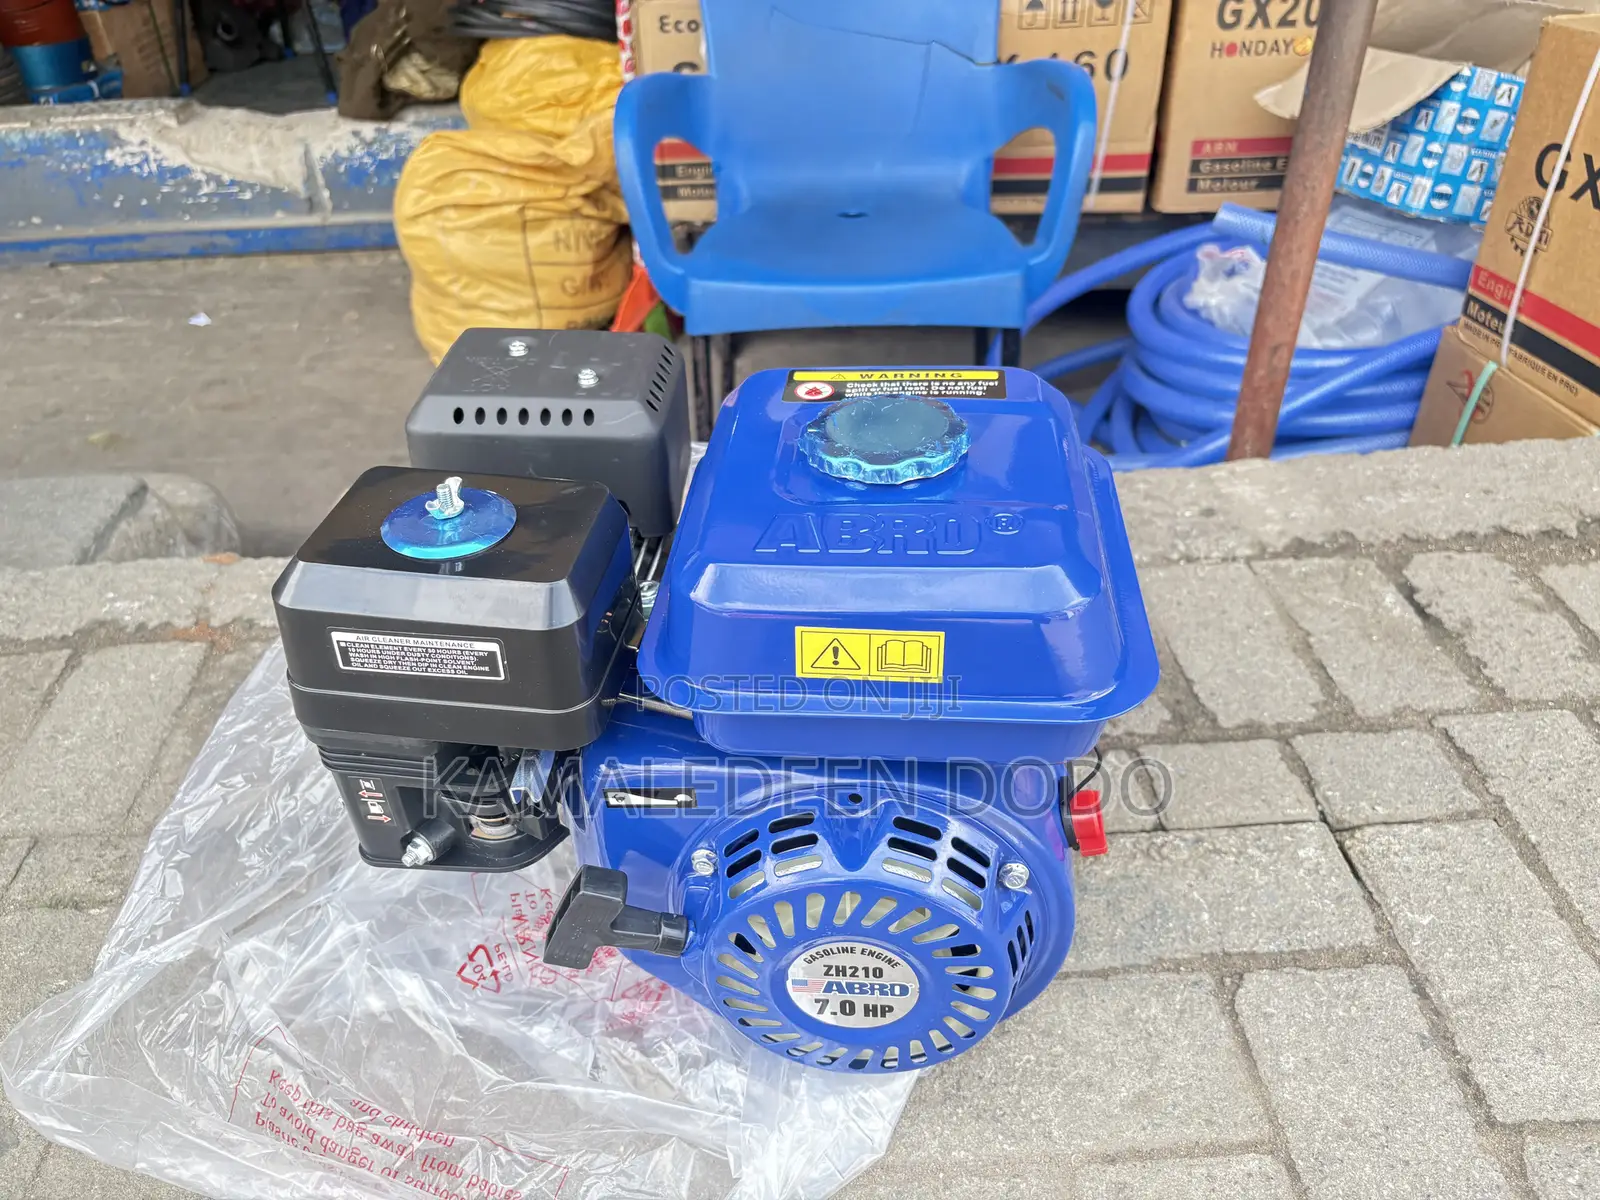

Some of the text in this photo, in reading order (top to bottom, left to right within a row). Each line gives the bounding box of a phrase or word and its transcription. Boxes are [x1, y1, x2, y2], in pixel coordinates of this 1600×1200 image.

[859, 372, 963, 380] WARNING
[370, 643, 403, 651] ELEMENT
[371, 636, 411, 645] CLEANER
[412, 639, 475, 649] MAINTENANCE
[463, 664, 490, 672] ENGINE
[803, 946, 901, 969] GASOLINE ENGINE
[822, 964, 884, 978] ZH210
[822, 980, 911, 997] ABRO
[814, 998, 895, 1018] 7.0 HP
